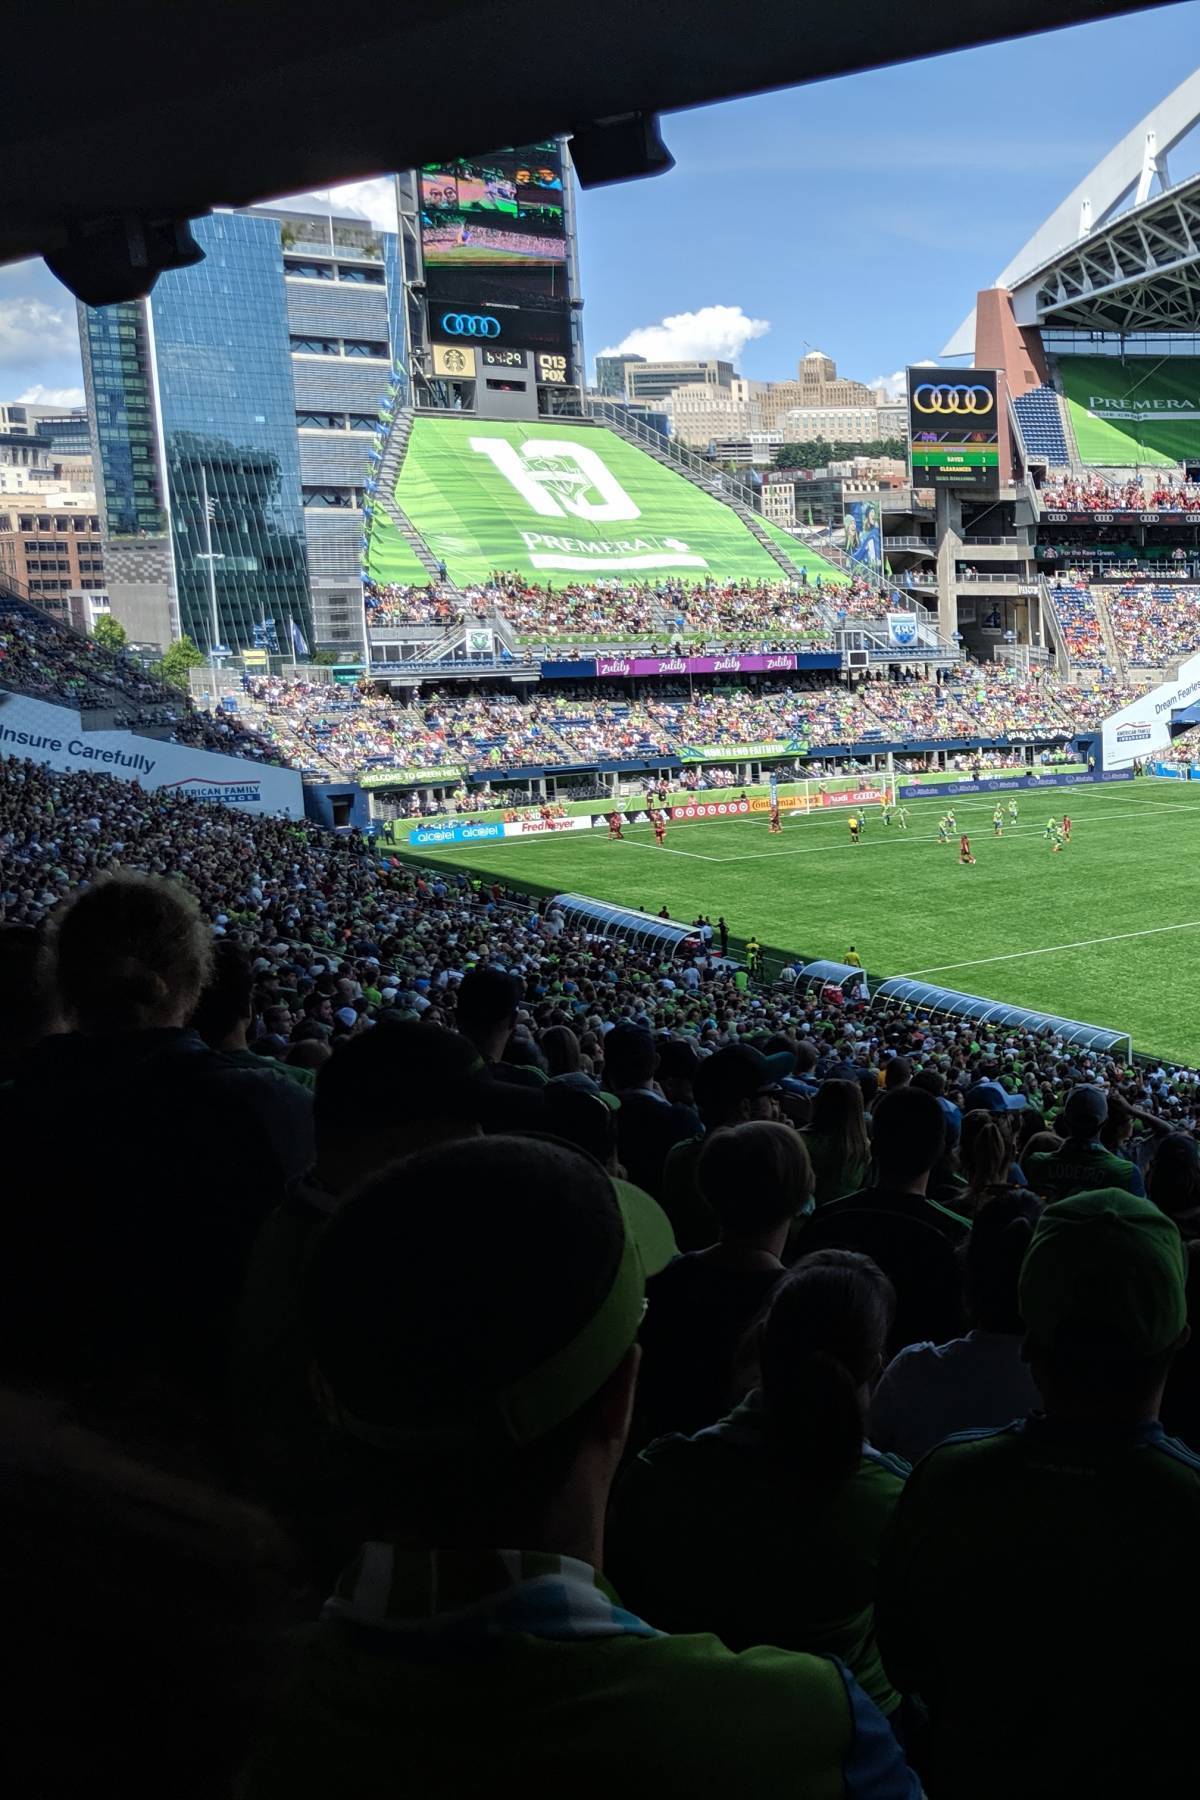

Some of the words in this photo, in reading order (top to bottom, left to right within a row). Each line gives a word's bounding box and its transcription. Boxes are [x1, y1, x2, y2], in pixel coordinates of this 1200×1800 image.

[539, 354, 566, 369] Q13
[541, 368, 566, 383] FOX
[1089, 396, 1195, 410] PREMERA
[520, 532, 651, 554] PREMERA
[1155, 695, 1178, 715] Dream
[68, 740, 156, 775] Carefully
[363, 773, 403, 783] WELCOME
[404, 772, 415, 780] TO
[225, 785, 260, 794] FAMILY
